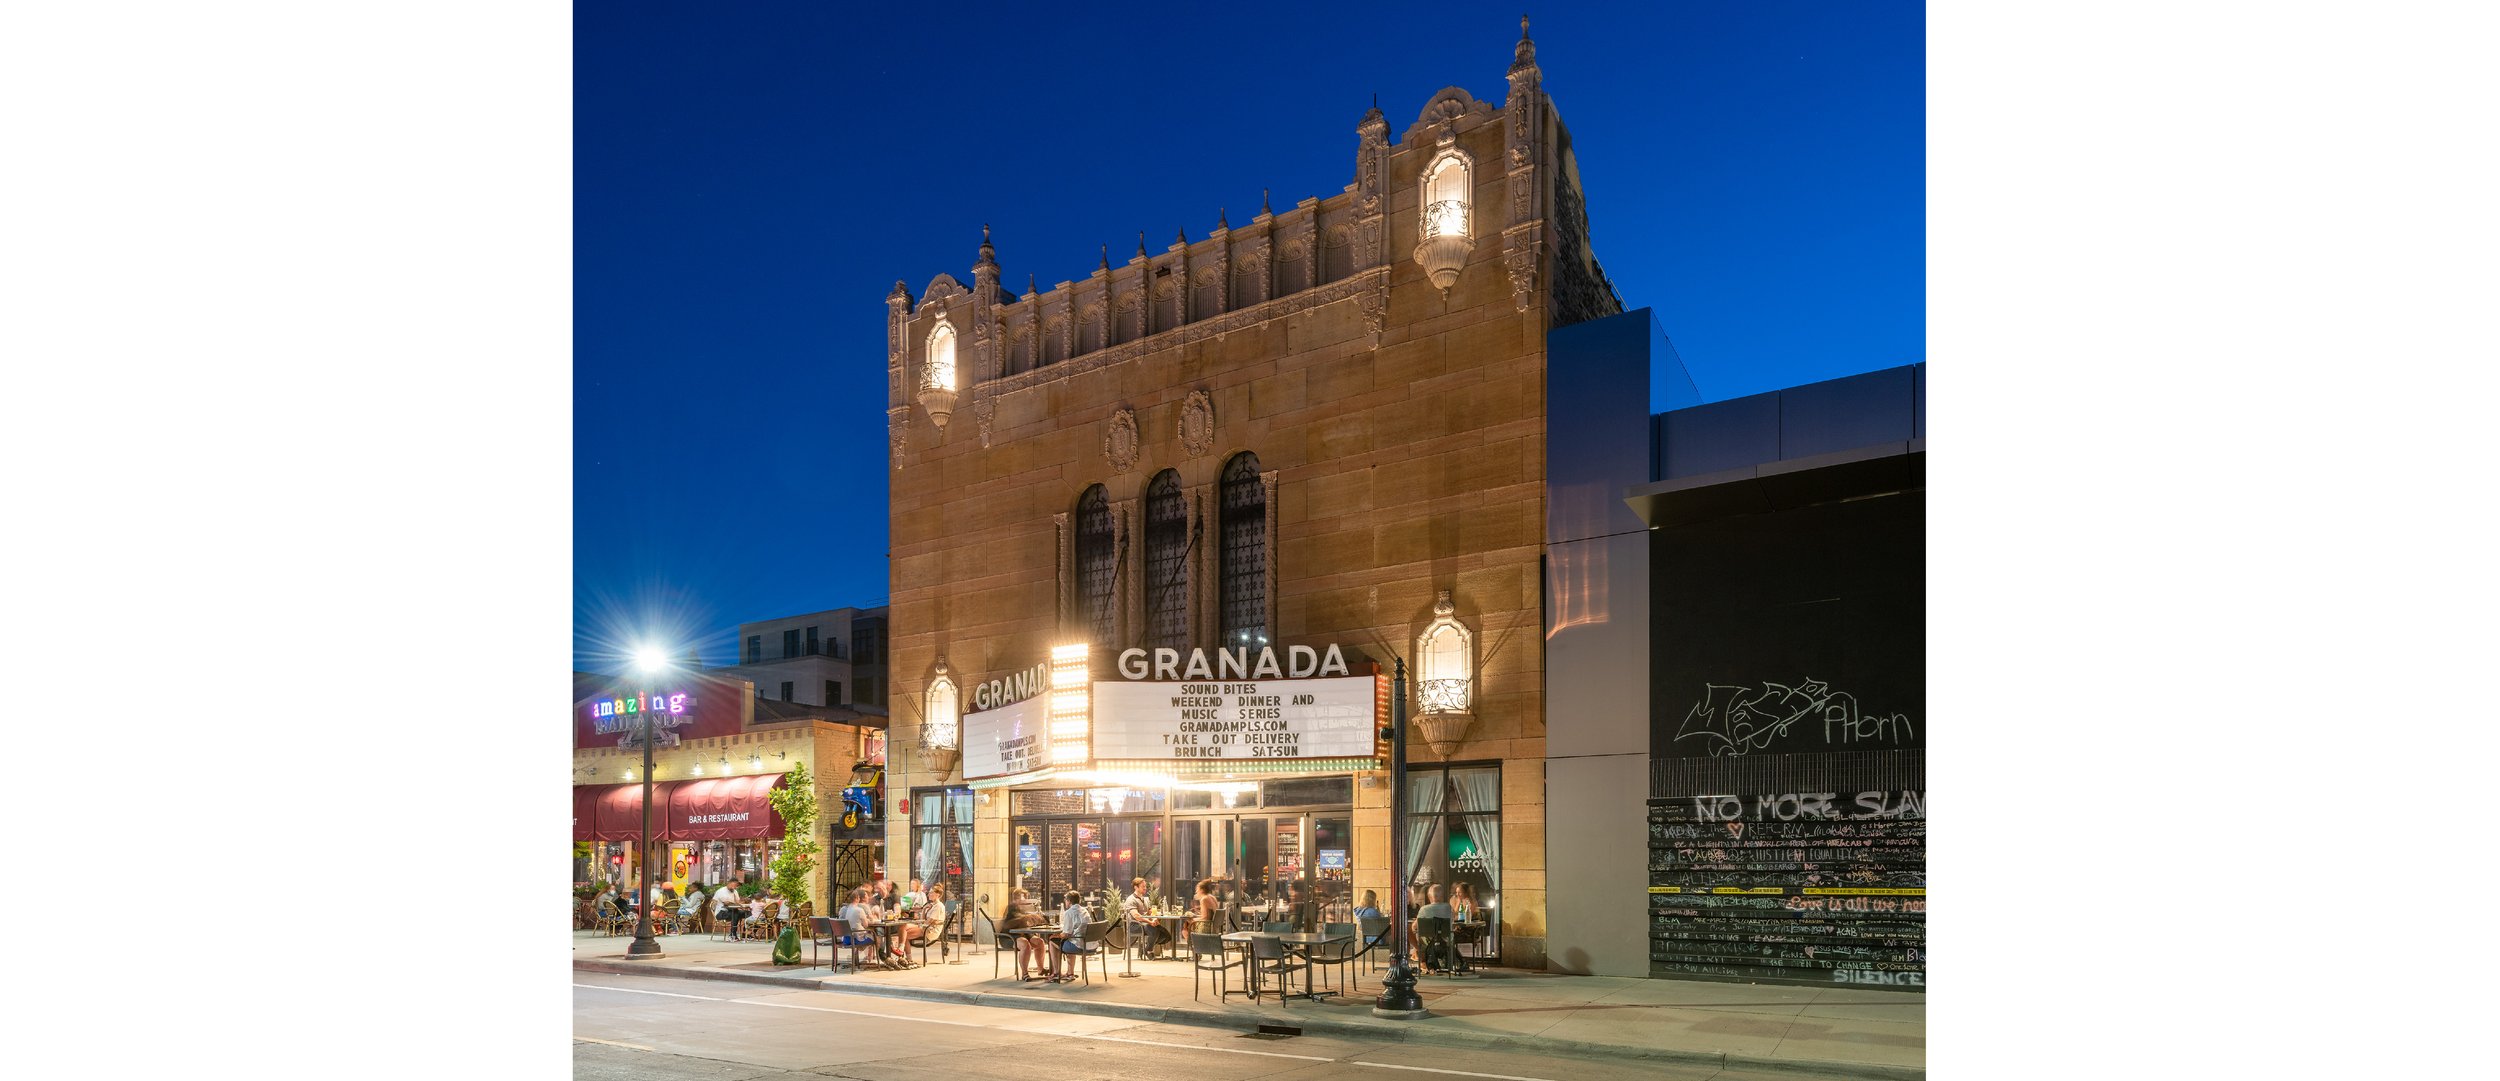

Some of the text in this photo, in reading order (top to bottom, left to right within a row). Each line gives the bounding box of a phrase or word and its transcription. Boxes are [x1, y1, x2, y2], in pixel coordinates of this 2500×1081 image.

[1118, 643, 1350, 680] GRANADA
[1182, 684, 1256, 695] SOUND BITES
[594, 691, 686, 717] amazing
[1172, 694, 1314, 707] WEEKEND DINNER AND
[1182, 708, 1280, 719] MUSIC SERIES
[1180, 721, 1288, 732] GRANADAMPLS.COM
[1163, 733, 1299, 745] TAKE OUT DELIVERY
[1175, 746, 1298, 757] BRUNCH SAT-SUN
[1695, 796, 1743, 823] NO
[1757, 792, 1838, 821] MORE
[689, 812, 749, 824] BAR & RESTAURANT
[1836, 961, 1874, 970] CHANGE
[1834, 969, 1925, 985] SILENCE
